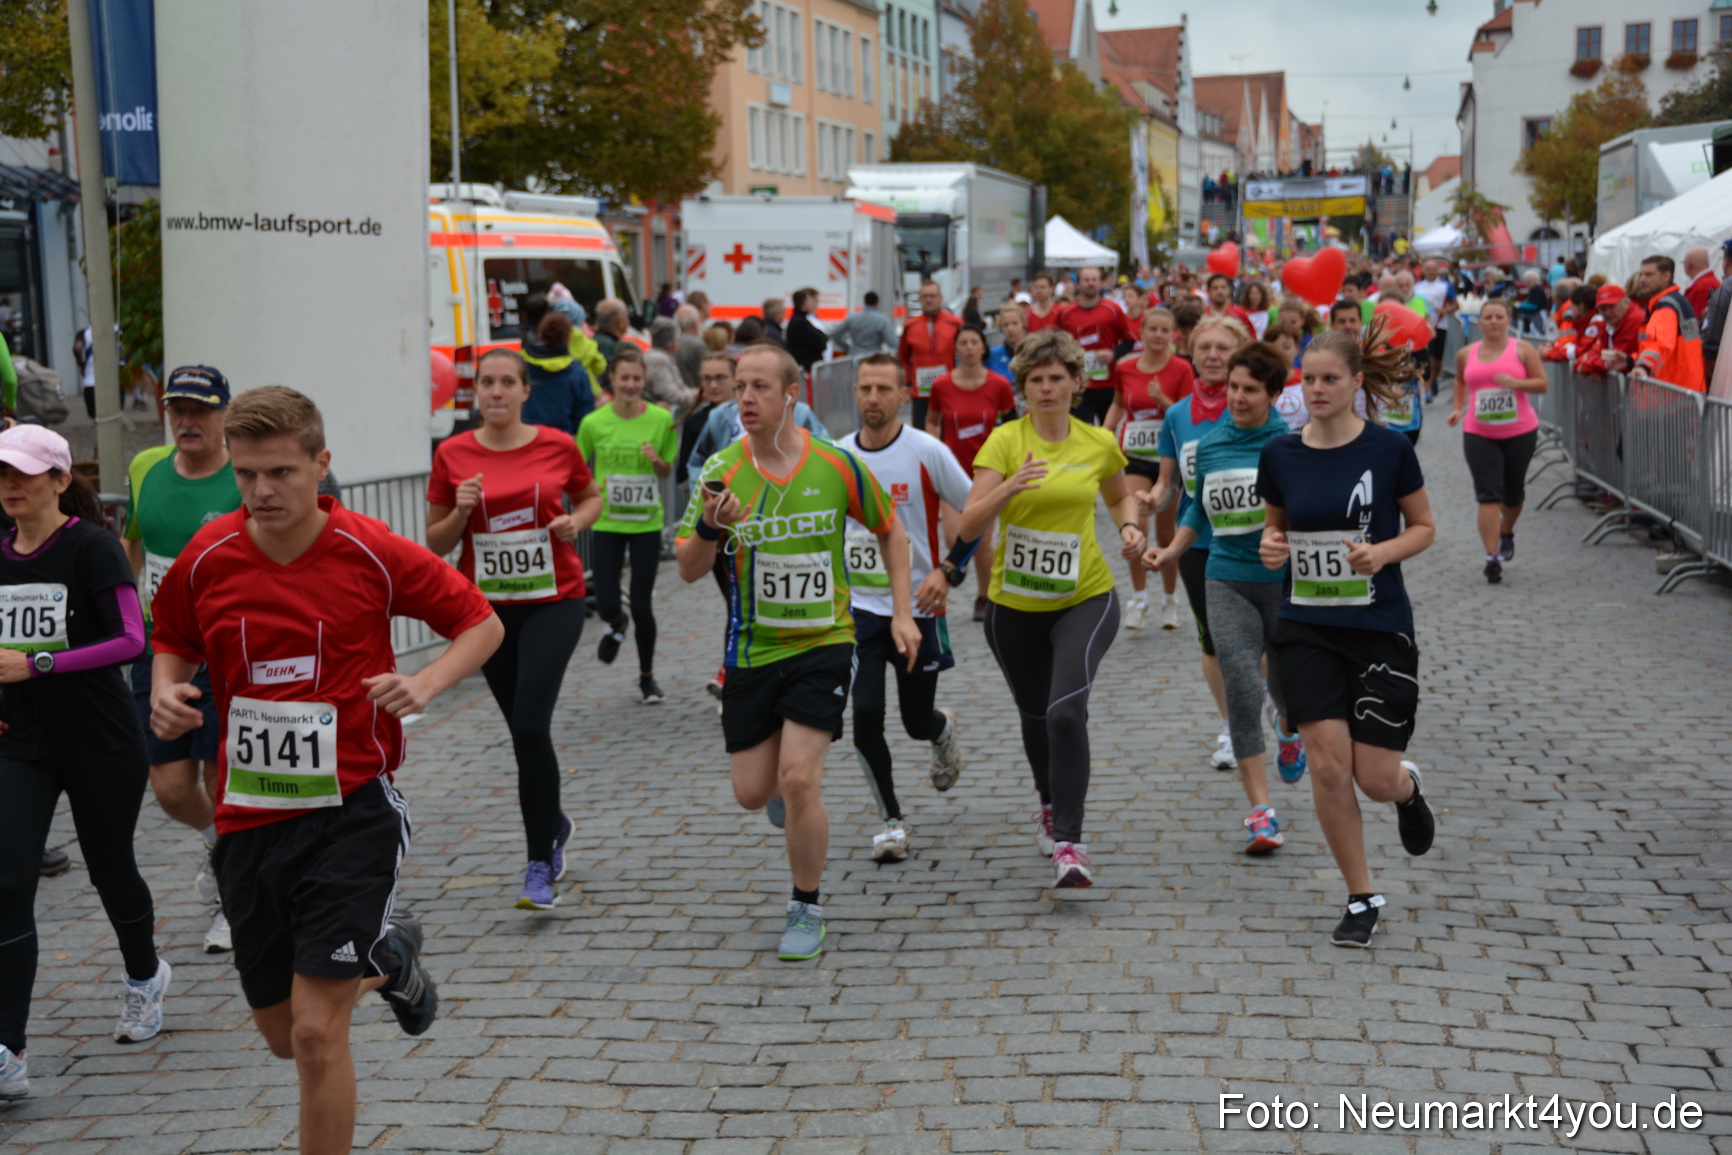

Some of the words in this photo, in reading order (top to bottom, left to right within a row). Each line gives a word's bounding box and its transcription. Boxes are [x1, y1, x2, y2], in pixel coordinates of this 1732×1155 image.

[166, 211, 382, 237] www.bmw-laufsport.de
[1479, 394, 1513, 412] 5024
[612, 485, 654, 503] 5074
[1209, 484, 1261, 511] 5028
[1311, 538, 1347, 547] Neumark
[483, 546, 546, 576] 5094
[1012, 542, 1072, 575] 5150
[762, 571, 827, 599] 5179
[1315, 585, 1340, 596] Jana
[10, 593, 49, 603] Neumarkt
[781, 606, 807, 618] Jens
[265, 664, 297, 678] DEHN
[230, 707, 259, 721] PARTL
[261, 713, 314, 724] Neumarkt
[236, 725, 320, 769] 5141
[257, 777, 299, 794] Timm
